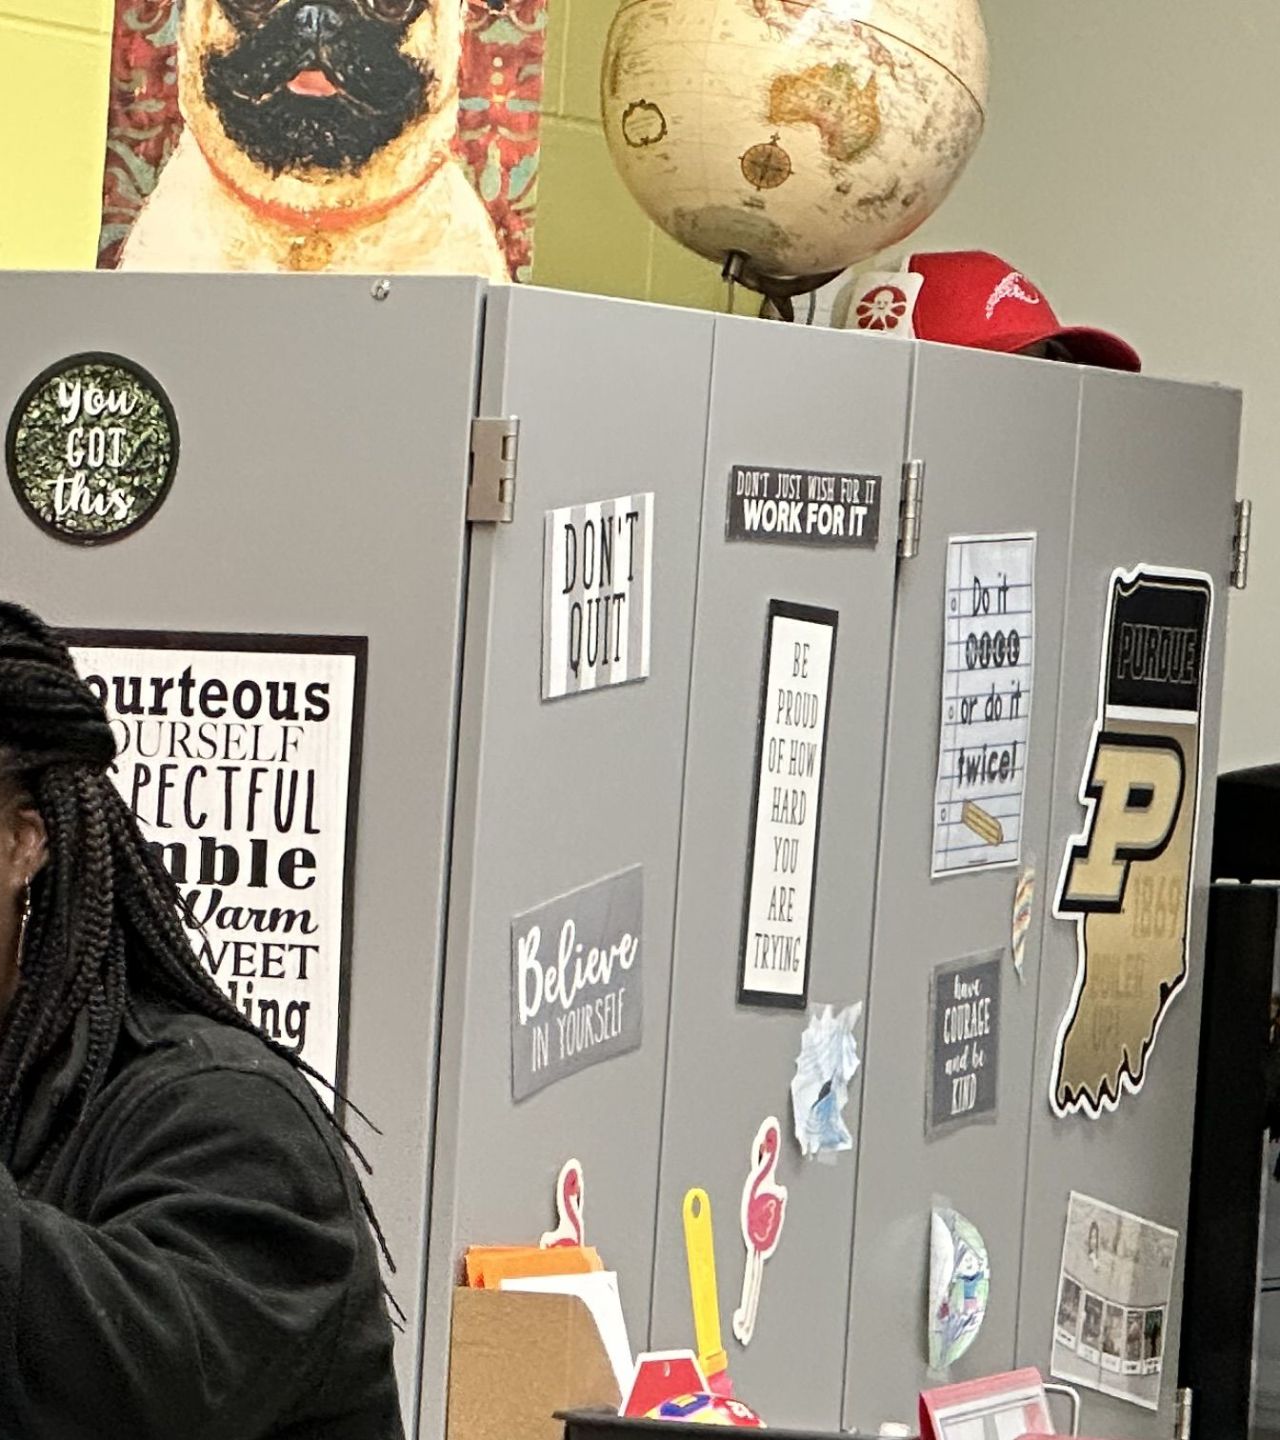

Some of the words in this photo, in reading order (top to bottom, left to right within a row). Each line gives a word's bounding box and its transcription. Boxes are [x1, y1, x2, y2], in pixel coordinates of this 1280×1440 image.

[66, 426, 127, 468] GOT
[47, 471, 135, 520] this
[736, 471, 770, 498] DON'T
[775, 473, 802, 500] JUST
[807, 475, 836, 502] WISH
[841, 477, 860, 504] FOR
[865, 479, 877, 504] IT
[743, 499, 804, 534] WORK
[806, 502, 845, 536] FOR
[849, 505, 868, 537] IT
[563, 511, 638, 594] DON'T
[972, 575, 990, 617] Do
[997, 571, 1009, 615] it
[570, 592, 625, 679] QUIT
[1117, 622, 1198, 685] PURDUE
[792, 641, 810, 679] BE
[84, 664, 330, 722] ourteous
[776, 688, 819, 730] PROUD
[961, 696, 977, 725] or
[985, 682, 1002, 722] do
[1010, 679, 1022, 721] it
[768, 737, 786, 775] OF
[789, 739, 818, 779] HOW
[108, 763, 320, 835] PECTFUL
[771, 786, 807, 826] HARD
[1058, 731, 1187, 914] P
[773, 835, 800, 874] YOU
[767, 885, 796, 923] ARE
[518, 918, 639, 1026] Believe
[754, 932, 801, 973] TRYING
[953, 973, 982, 1001] have
[532, 1022, 549, 1072] IN
[556, 987, 626, 1060] YOURSELF
[943, 997, 991, 1045] COURAGE
[945, 1044, 970, 1076] and
[972, 1040, 985, 1069] be
[950, 1072, 977, 1115] KIND
